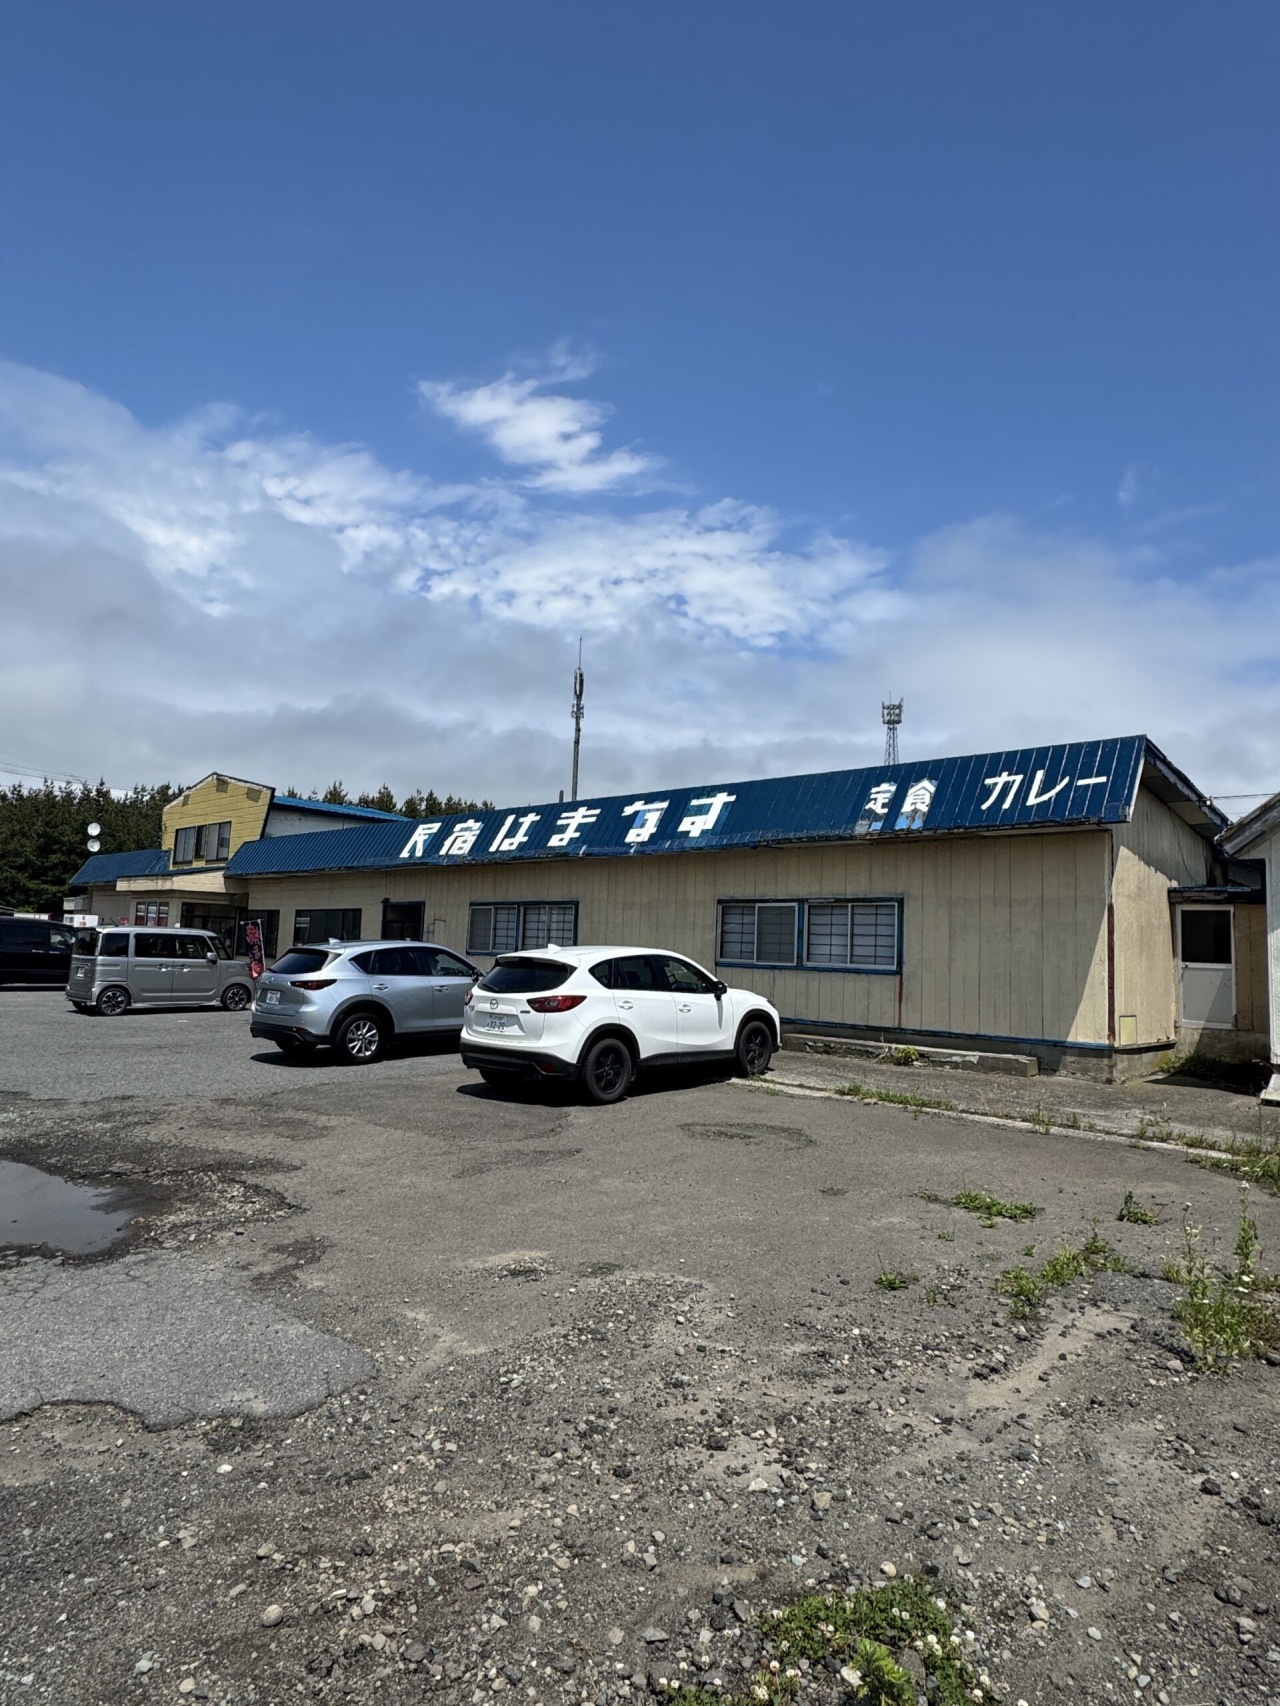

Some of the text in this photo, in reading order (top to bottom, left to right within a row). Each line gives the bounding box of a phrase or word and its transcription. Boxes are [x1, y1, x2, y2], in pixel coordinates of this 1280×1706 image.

[865, 769, 1107, 814] 定食 カレー
